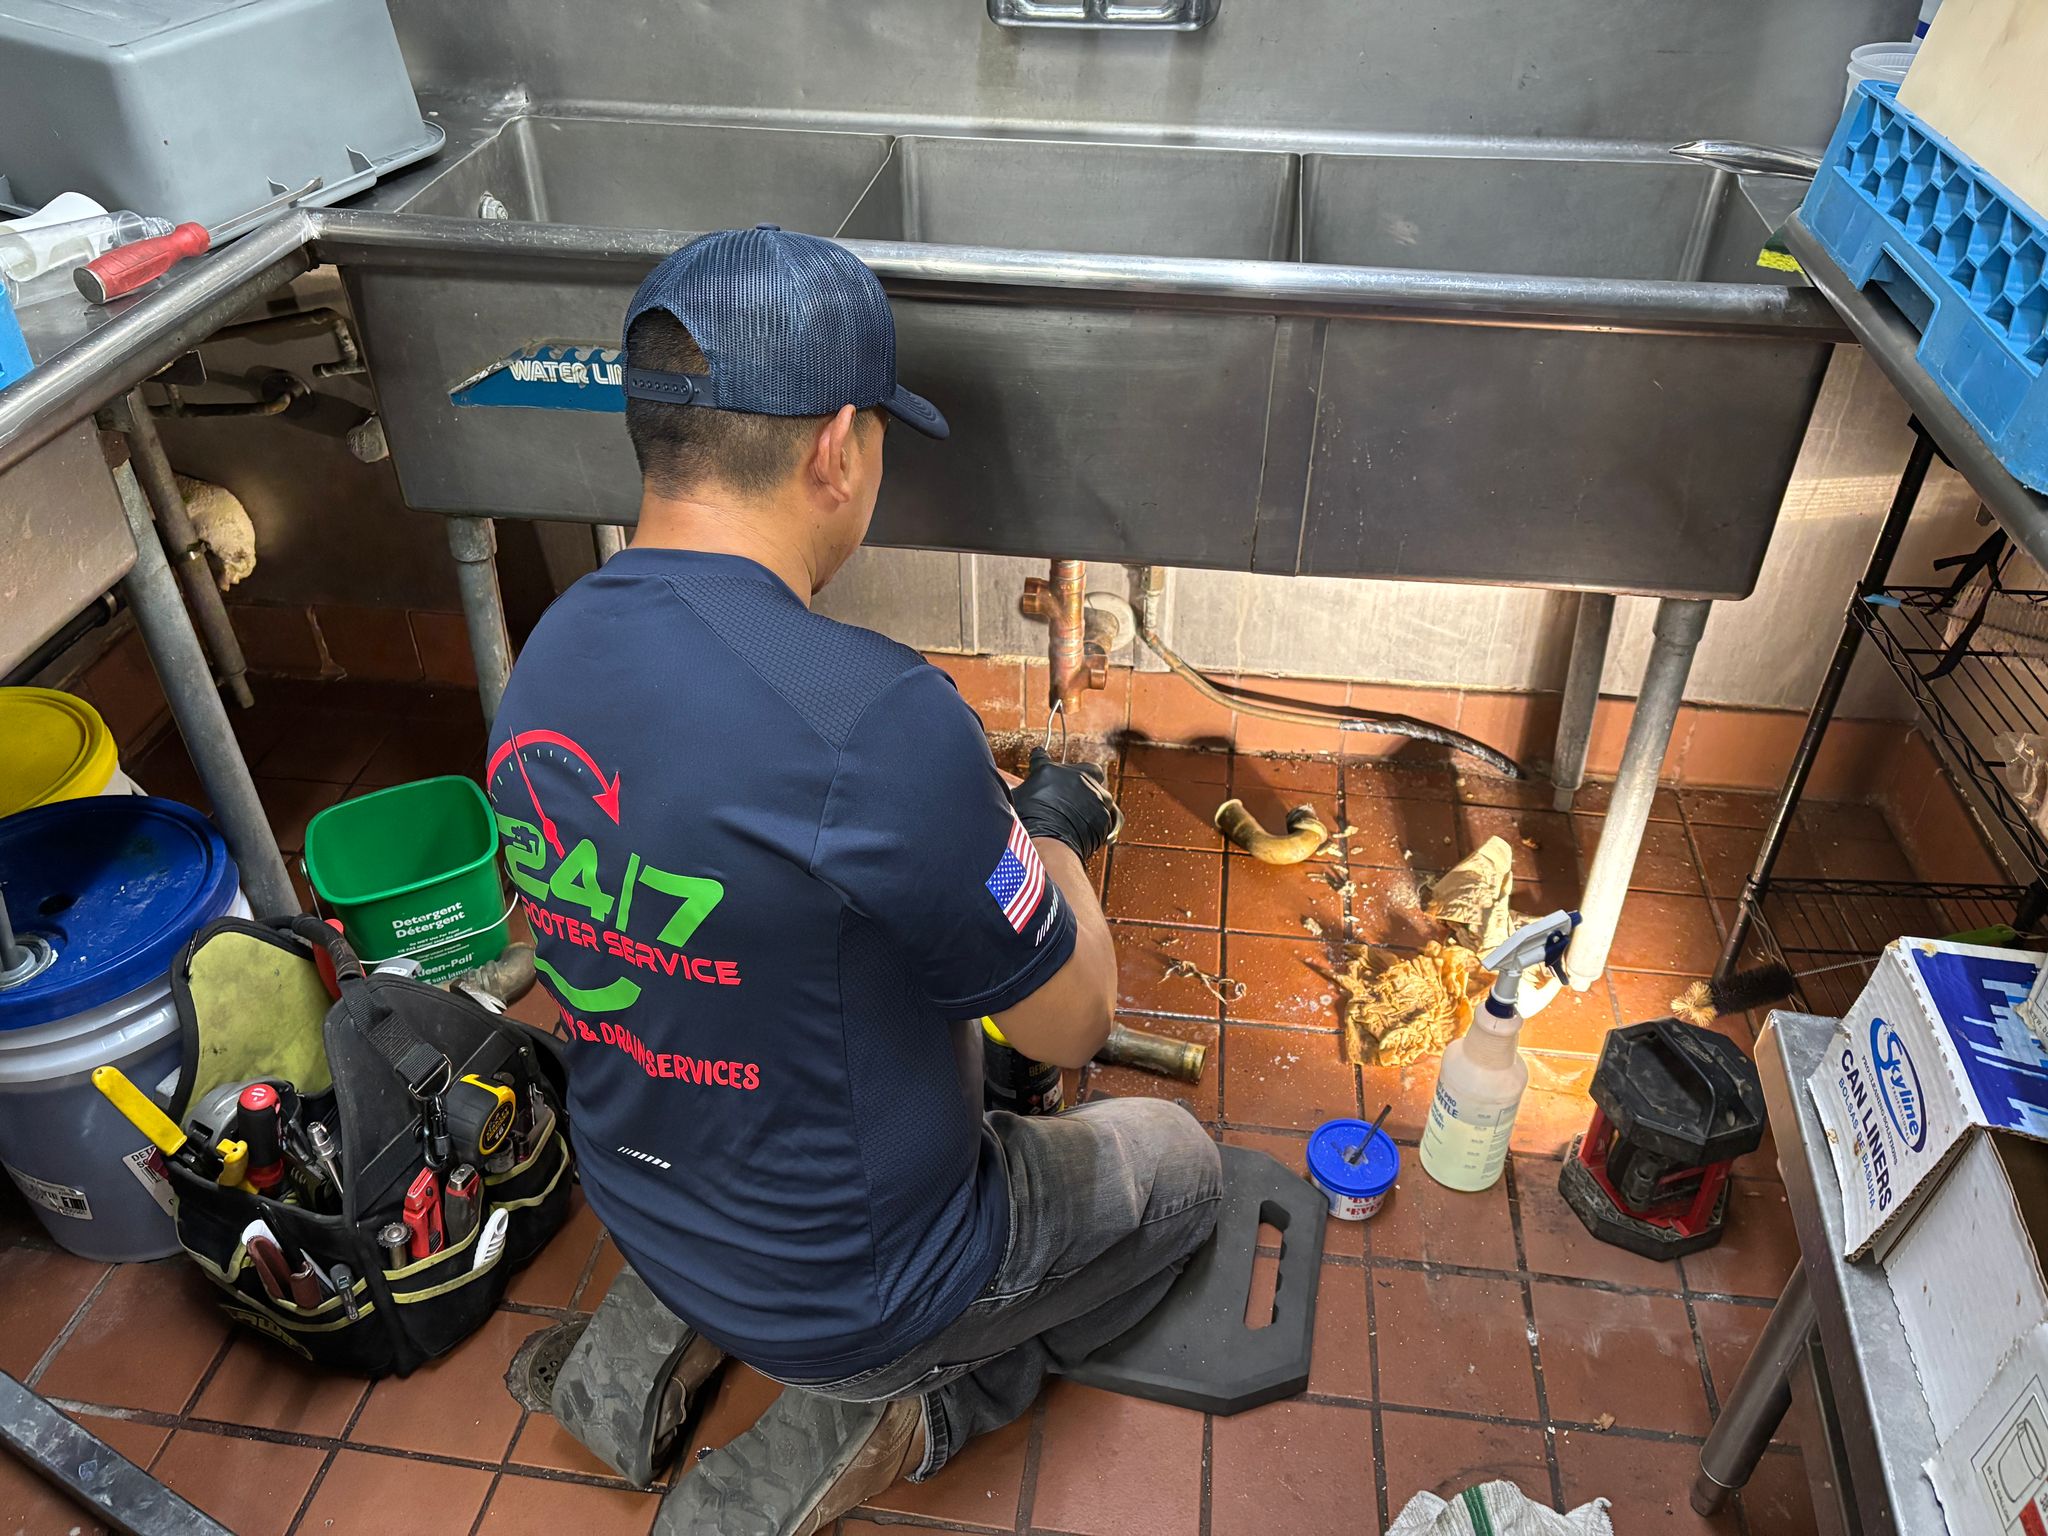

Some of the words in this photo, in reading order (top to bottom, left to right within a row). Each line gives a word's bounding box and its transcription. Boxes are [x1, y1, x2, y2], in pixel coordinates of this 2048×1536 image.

[509, 360, 589, 384] WATER
[495, 812, 724, 947] 24/7
[392, 902, 463, 929] Detergent
[396, 911, 466, 938] Détergent
[417, 953, 473, 977] leen-Pail
[602, 930, 742, 985] SERVICE
[576, 1020, 601, 1043] &
[600, 1022, 646, 1068] DRAIN
[645, 1050, 760, 1090] SERVICES
[1028, 1062, 1053, 1077] BERN
[1881, 1031, 1919, 1136] Skyline
[1838, 1077, 1859, 1130] BOLSAS
[1856, 1131, 1866, 1152] DE
[1861, 1153, 1876, 1209] BASURA
[1841, 1049, 1868, 1109] CAN
[1862, 1107, 1892, 1212] LINERS
[1882, 1116, 1898, 1165] SOLUTIONS
